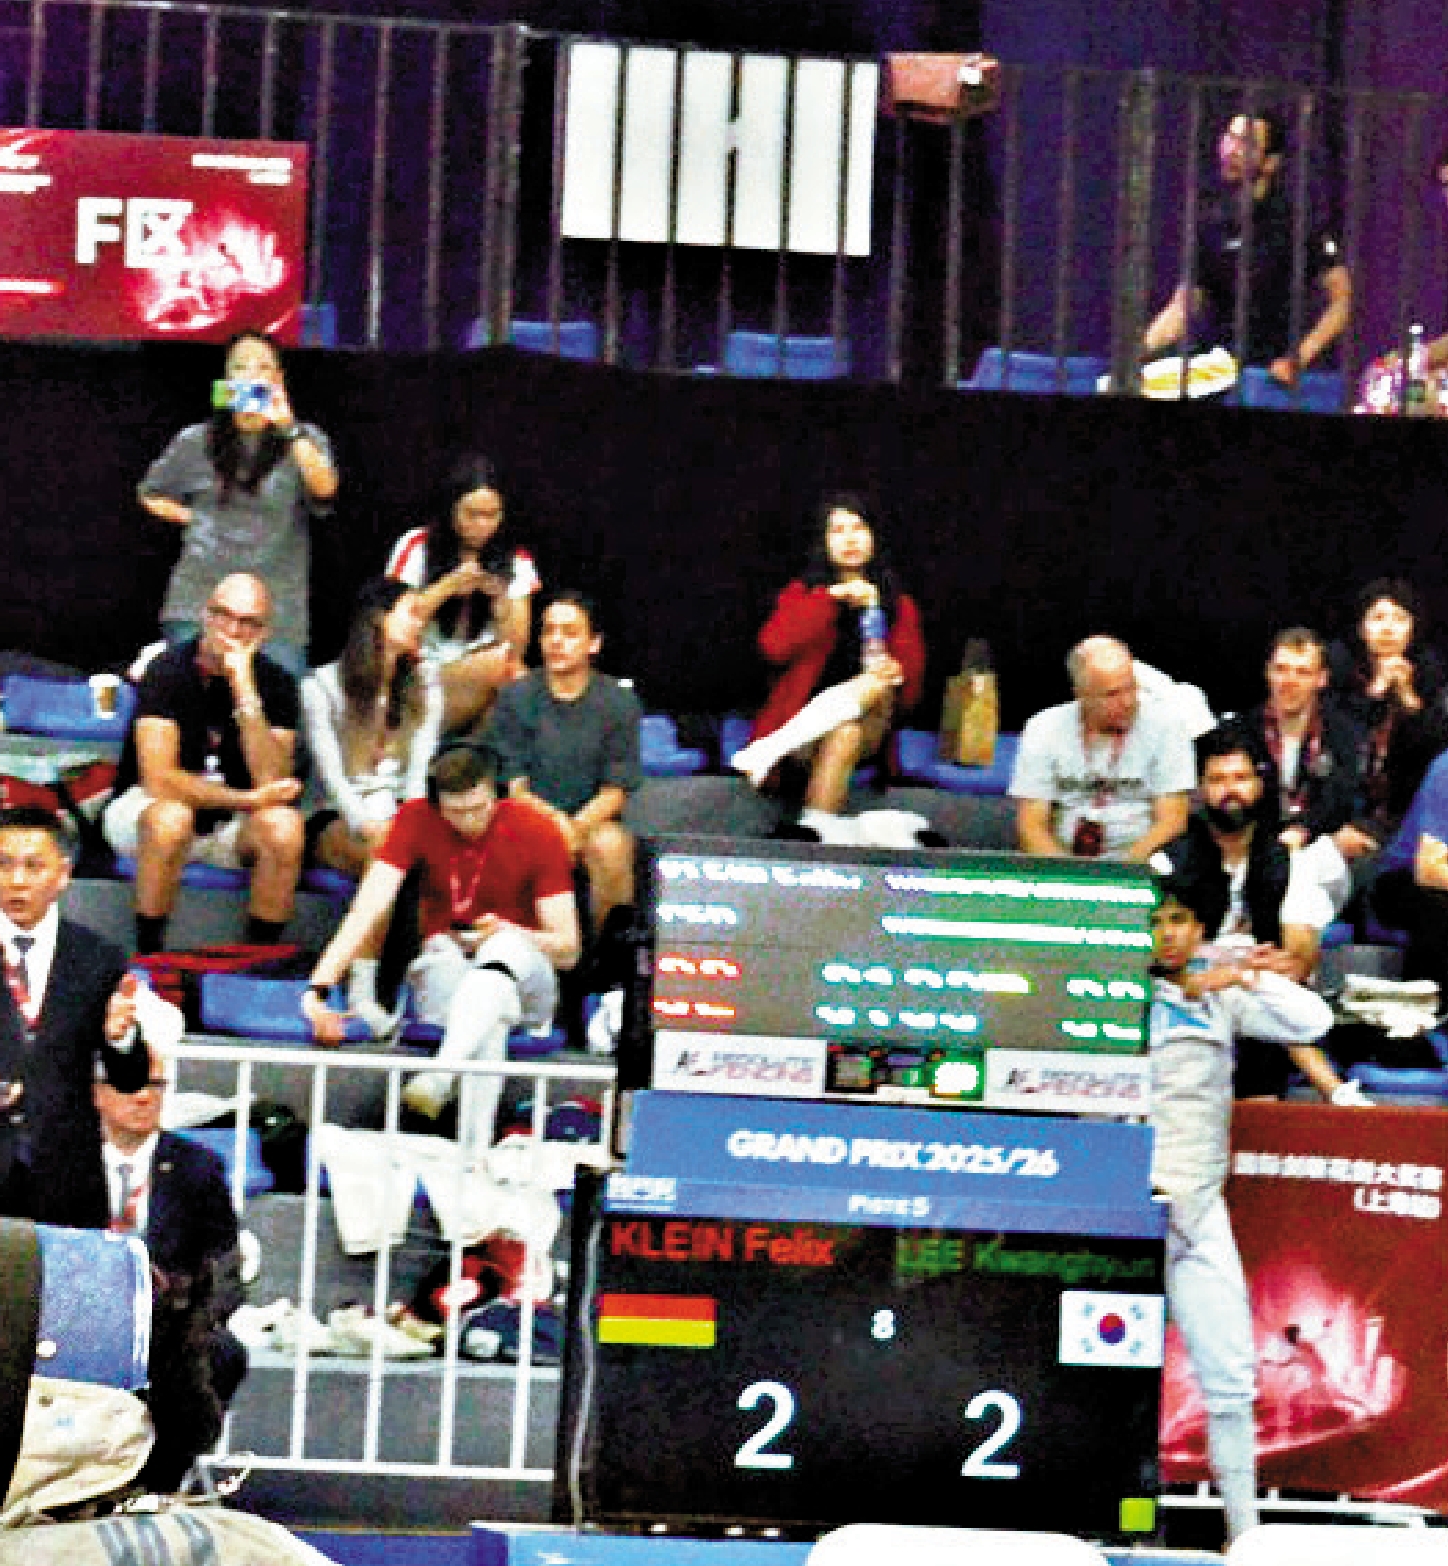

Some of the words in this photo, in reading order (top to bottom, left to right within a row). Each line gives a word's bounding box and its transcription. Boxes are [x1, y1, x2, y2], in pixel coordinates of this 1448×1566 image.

[725, 1127, 848, 1165] GRAND
[848, 1137, 921, 1171] PRIX
[610, 1220, 735, 1262] KLEIN
[743, 1226, 836, 1268] Felix
[871, 1310, 893, 1338] 8
[736, 1382, 794, 1468] 2
[962, 1390, 1020, 1479] 2
